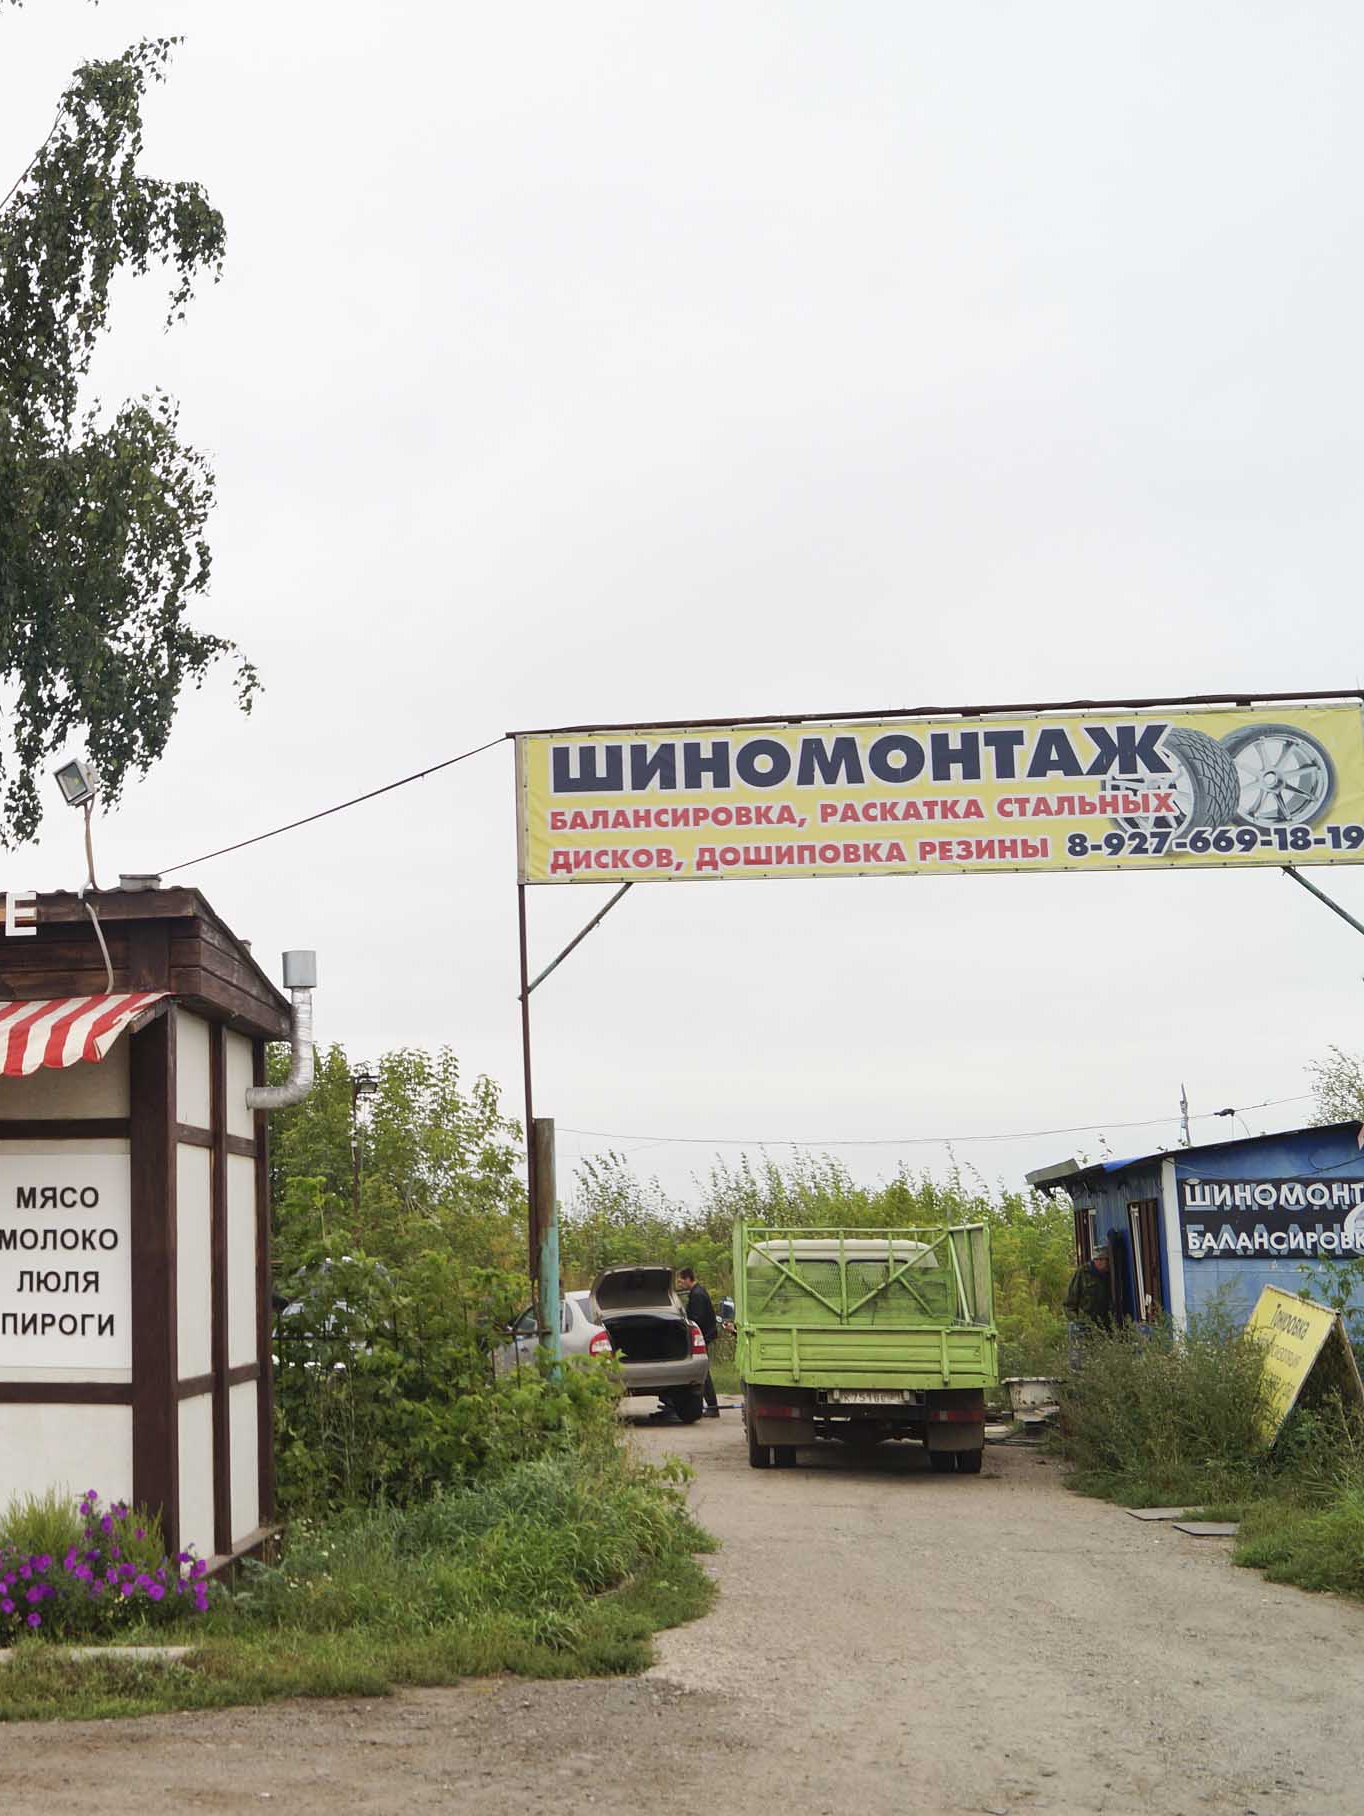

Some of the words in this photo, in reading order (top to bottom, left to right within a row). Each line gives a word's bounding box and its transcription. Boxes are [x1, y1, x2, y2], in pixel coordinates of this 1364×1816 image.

[552, 724, 1174, 793] ШИНОМОНТАЖ
[550, 804, 807, 831] БАЛАНСИРОВКА,
[819, 797, 985, 823] РАСКАТКА
[996, 792, 1176, 818] СТАЛЬНЫХ
[549, 848, 684, 875] ДИСКОВ,
[695, 842, 907, 872] ДОШИПОВКА
[919, 838, 1050, 862] РЕЗИНЫ
[1067, 825, 1364, 857] 8-927-669-18-19
[16, 1186, 100, 1209] МЯСО
[17, 1270, 100, 1293] ЛЮЛЯ
[1, 1312, 115, 1337] ПИРОГИ
